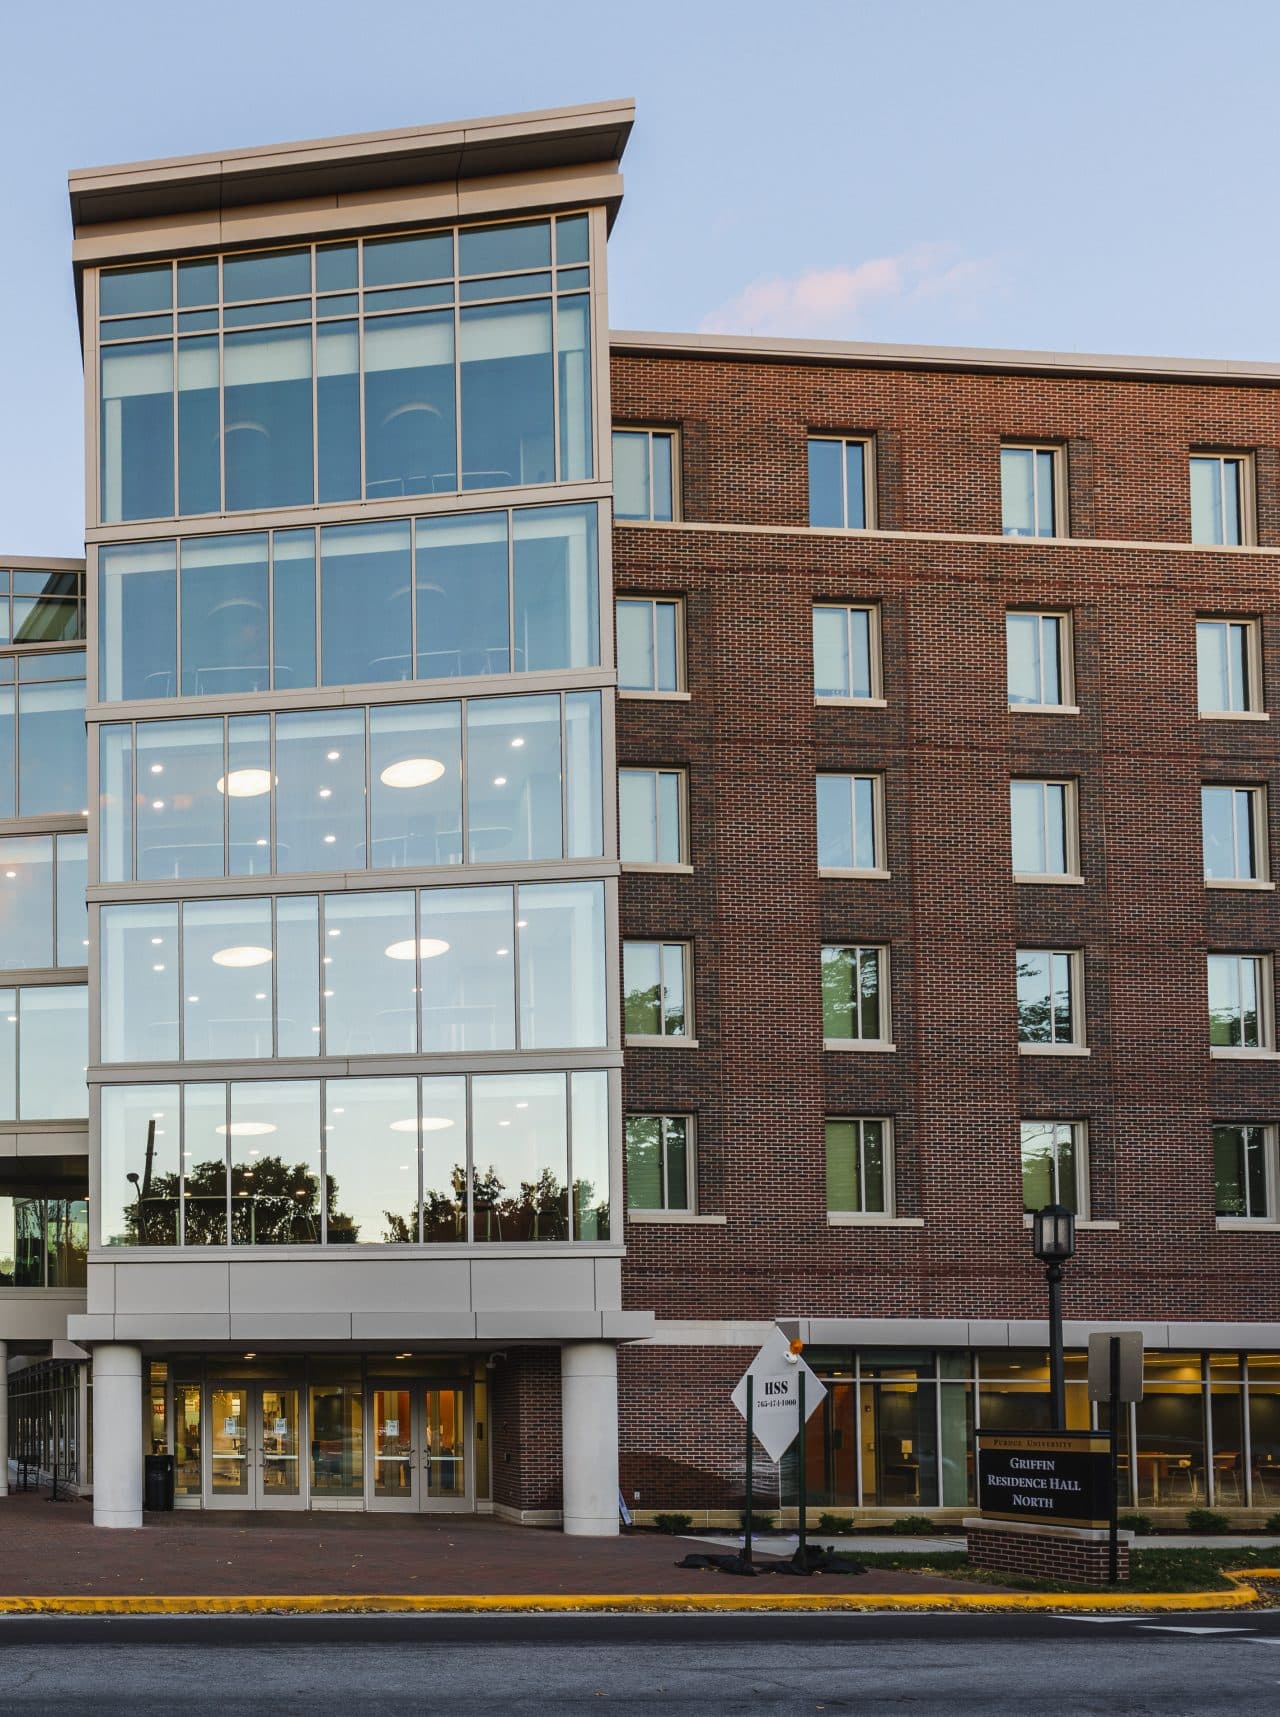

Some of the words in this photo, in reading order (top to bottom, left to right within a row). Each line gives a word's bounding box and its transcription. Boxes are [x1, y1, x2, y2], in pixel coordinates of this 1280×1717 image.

[765, 1381, 788, 1395] HSS
[1010, 1457, 1056, 1471] GRIFFIN
[987, 1474, 1048, 1489] RESIDENCE
[1049, 1478, 1081, 1491] HALL
[1012, 1494, 1054, 1508] NORTH
